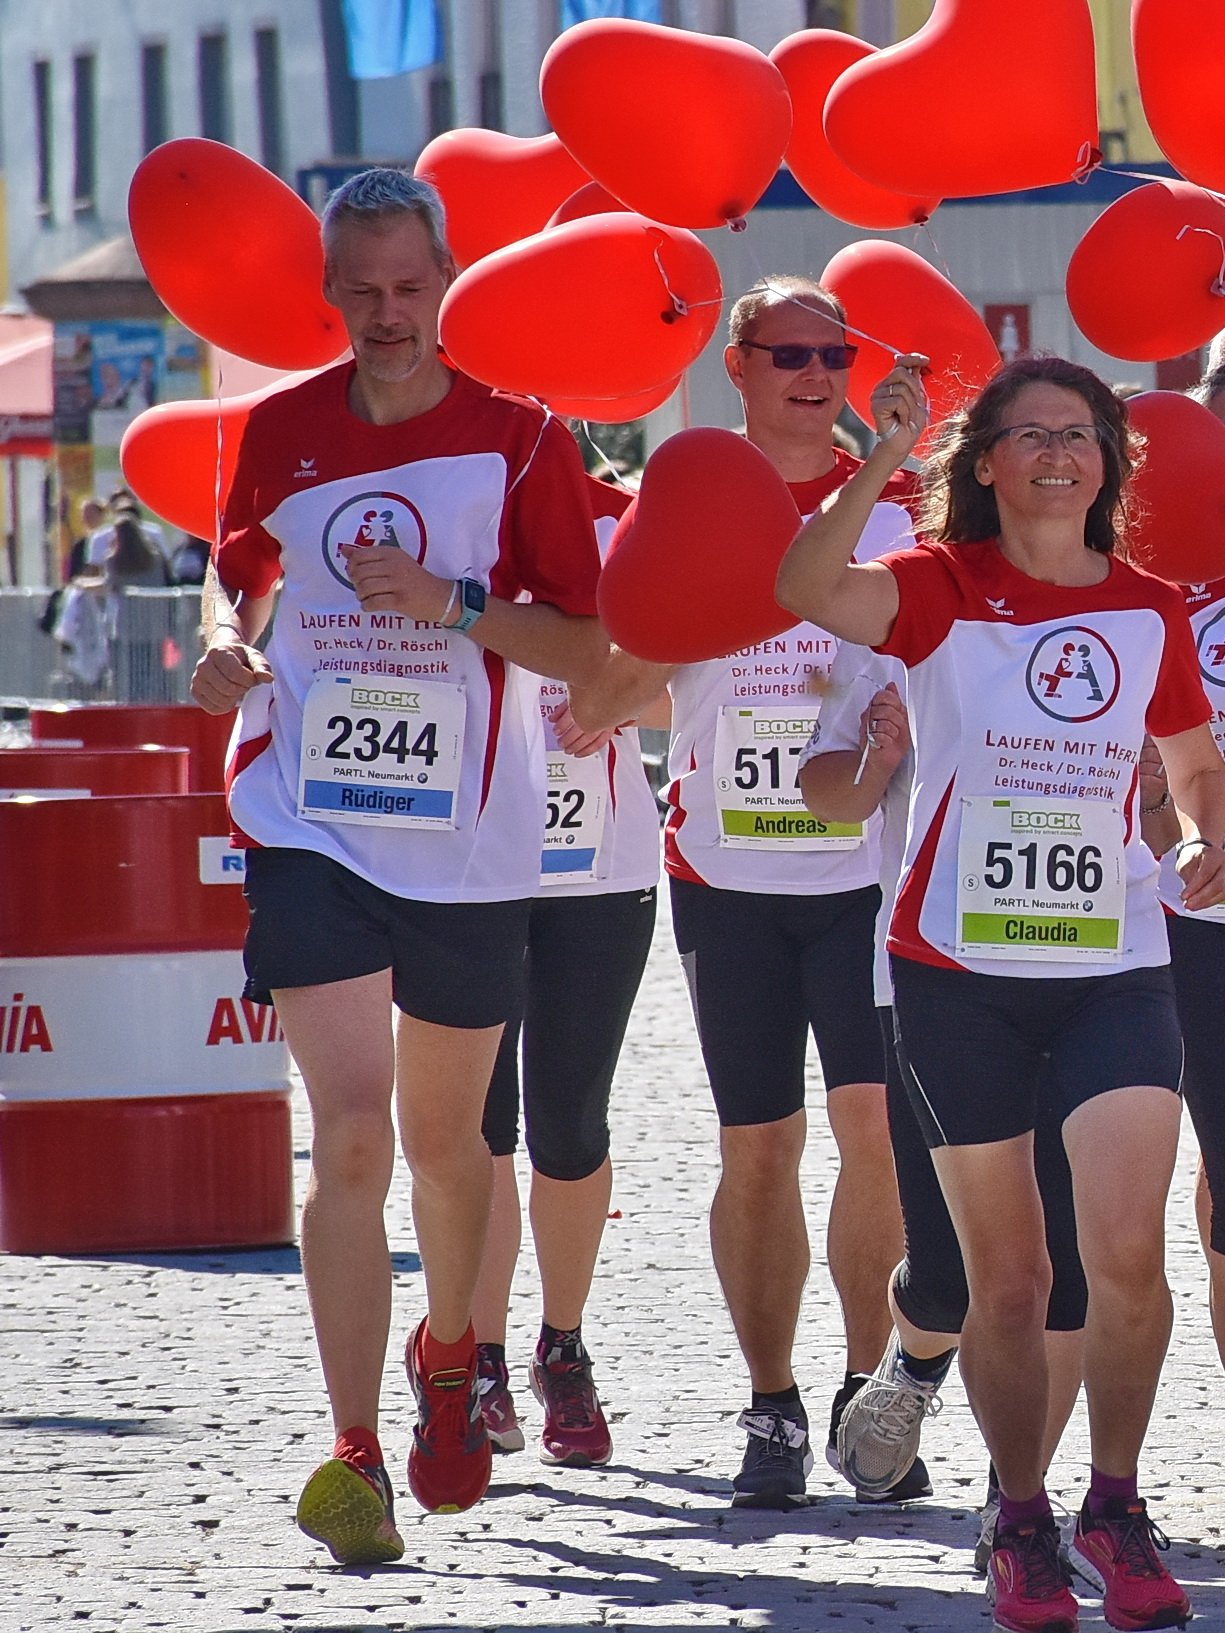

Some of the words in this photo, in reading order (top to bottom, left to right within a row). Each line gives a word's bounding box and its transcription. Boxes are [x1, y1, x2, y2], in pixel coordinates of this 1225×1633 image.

[1185, 592, 1212, 604] erima
[300, 612, 361, 630] LAUFEN
[371, 615, 404, 630] MIT
[314, 639, 332, 651] Dr.
[334, 638, 364, 650] Heck
[377, 639, 396, 651] Dr.
[401, 639, 448, 652] Röschl
[797, 641, 831, 654] MIT
[732, 667, 750, 678] Dr.
[755, 664, 789, 676] Heck
[351, 688, 423, 708] BOCK
[541, 684, 567, 696] Rös
[753, 719, 819, 735] BOCK
[325, 715, 439, 767] 2344
[986, 729, 1055, 752] LAUFEN
[1064, 740, 1098, 757] MIT
[1105, 741, 1138, 764] HERZ
[333, 767, 366, 778] PARTL
[368, 769, 414, 782] Neumarkt
[734, 746, 802, 790] 517
[999, 757, 1017, 769] Dr.
[1021, 759, 1053, 773] Heck
[1067, 764, 1084, 776] Dr.
[341, 788, 415, 814] Rüdiger
[545, 789, 585, 829] 52
[745, 797, 775, 806] PARTL
[778, 797, 804, 806] Neum
[754, 815, 828, 834] Andreas
[1011, 811, 1082, 830] BOCK
[984, 841, 1103, 893] 5166
[994, 898, 1029, 908] PARTL
[1032, 899, 1079, 910] Neumarkt
[1005, 919, 1078, 942] Claudia
